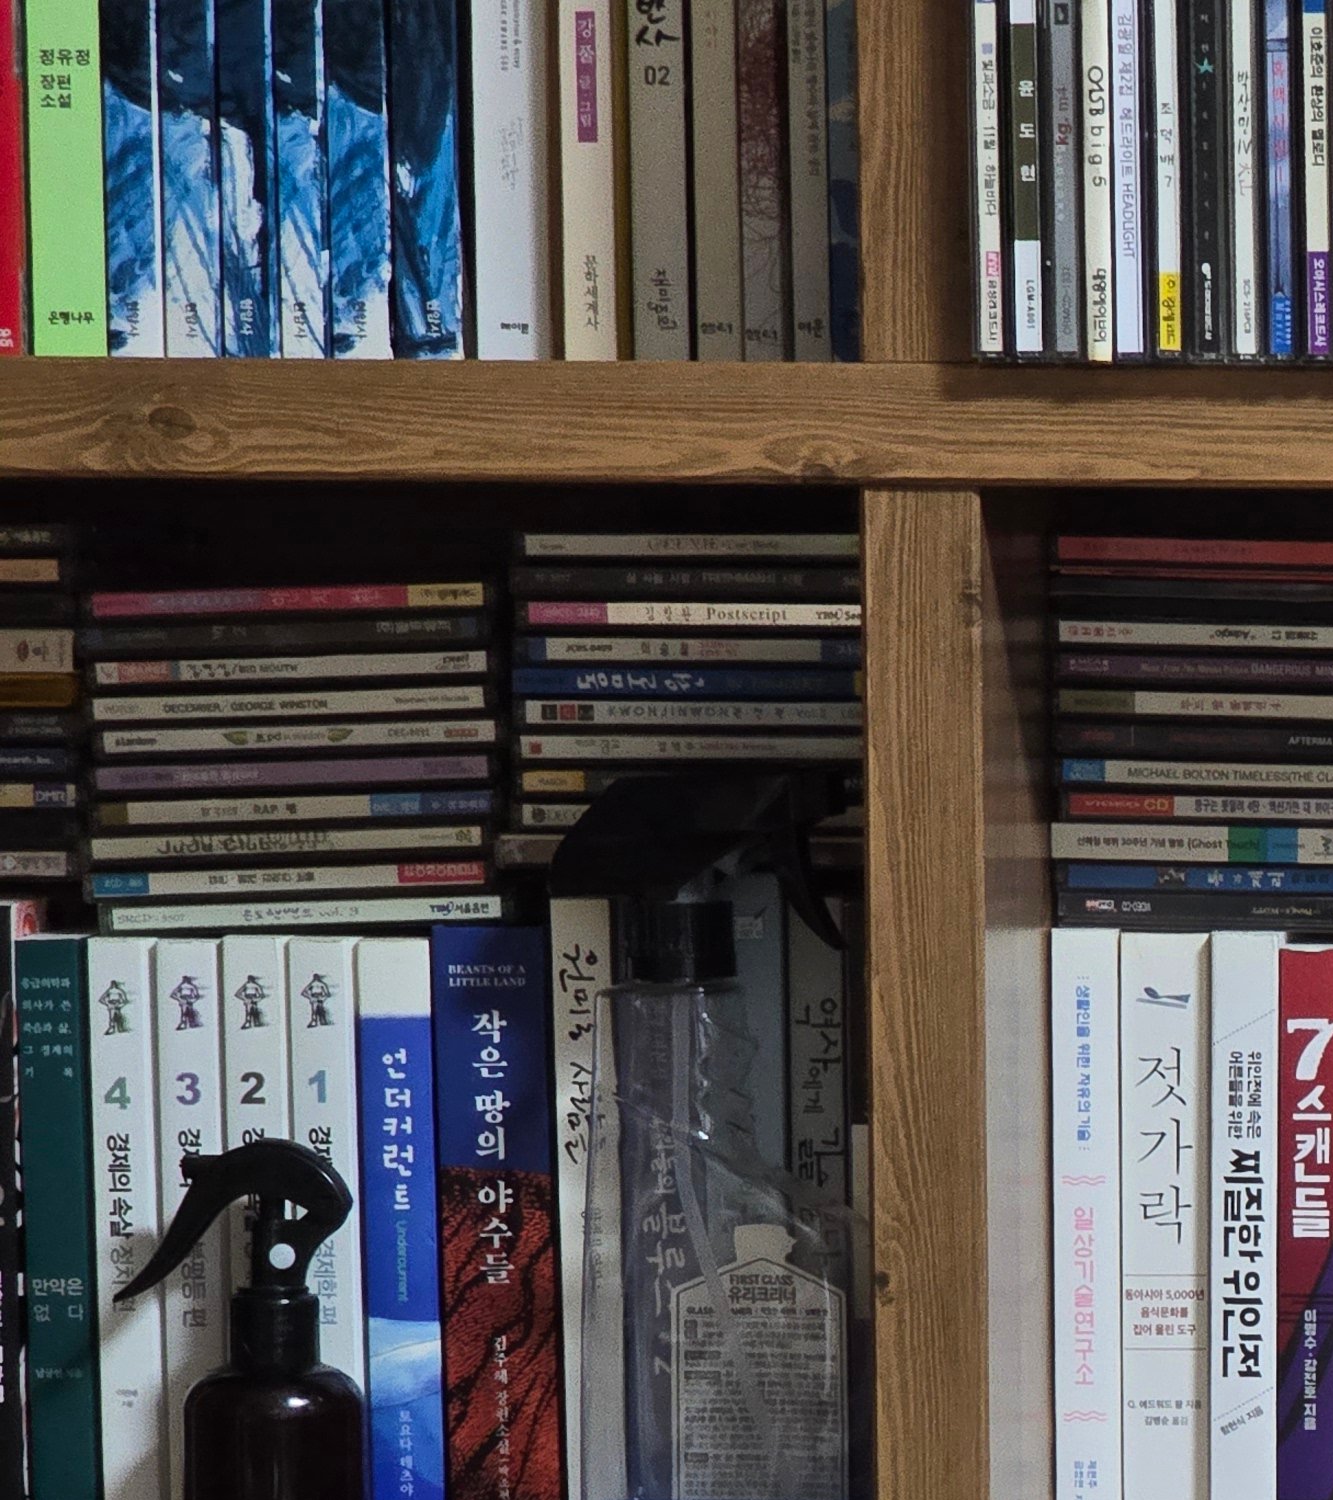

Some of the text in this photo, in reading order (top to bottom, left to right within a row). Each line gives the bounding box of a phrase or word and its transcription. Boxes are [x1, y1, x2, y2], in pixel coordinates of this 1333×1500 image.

[39, 49, 90, 66] 정유정
[40, 75, 72, 90] 장편
[643, 65, 671, 86] 02
[40, 94, 72, 110] 소설
[1122, 183, 1136, 259] HEADLIGHT
[47, 310, 95, 325] 은행나무
[1310, 257, 1329, 348] 오아시스레코드사
[705, 606, 788, 622] Postscript
[1126, 767, 1231, 783] MICHAEL BOLTON
[103, 1076, 131, 1111] 4
[175, 1071, 202, 1107] 3
[239, 1071, 266, 1105] 2
[307, 1069, 328, 1104] 1
[381, 1047, 414, 1212] 언더커런트
[1134, 1046, 1194, 1246] 젓가락
[470, 1009, 516, 1286] 작은 땅의 야수들
[106, 1132, 134, 1239] 경제의 속살
[1221, 1148, 1266, 1378] 찌질한 위인전
[1139, 1306, 1190, 1319] 음식문화를
